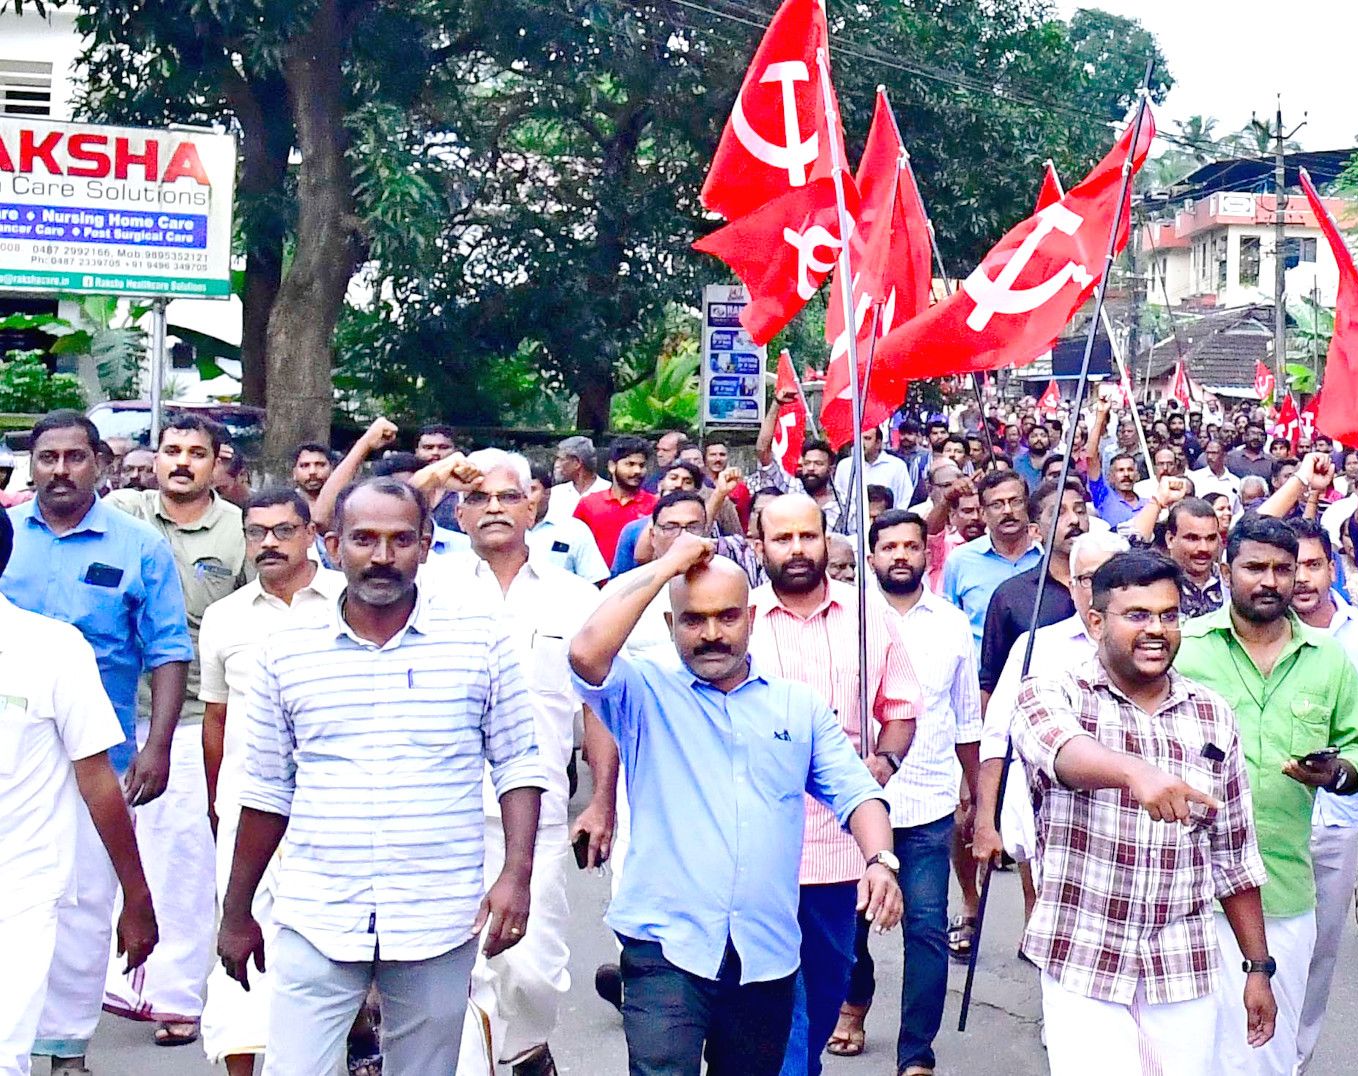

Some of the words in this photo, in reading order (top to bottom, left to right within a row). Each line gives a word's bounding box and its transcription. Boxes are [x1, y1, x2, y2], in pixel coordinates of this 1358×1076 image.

[0, 129, 211, 186] KSHA
[12, 176, 74, 197] Care
[87, 181, 207, 206] Solutions
[0, 209, 19, 221] re
[42, 208, 104, 229] Nursing
[108, 213, 154, 229] Home
[158, 215, 194, 231] Care
[35, 224, 64, 236] Care
[83, 227, 111, 239] Post
[114, 228, 163, 242] Surgical
[165, 231, 194, 243] Care
